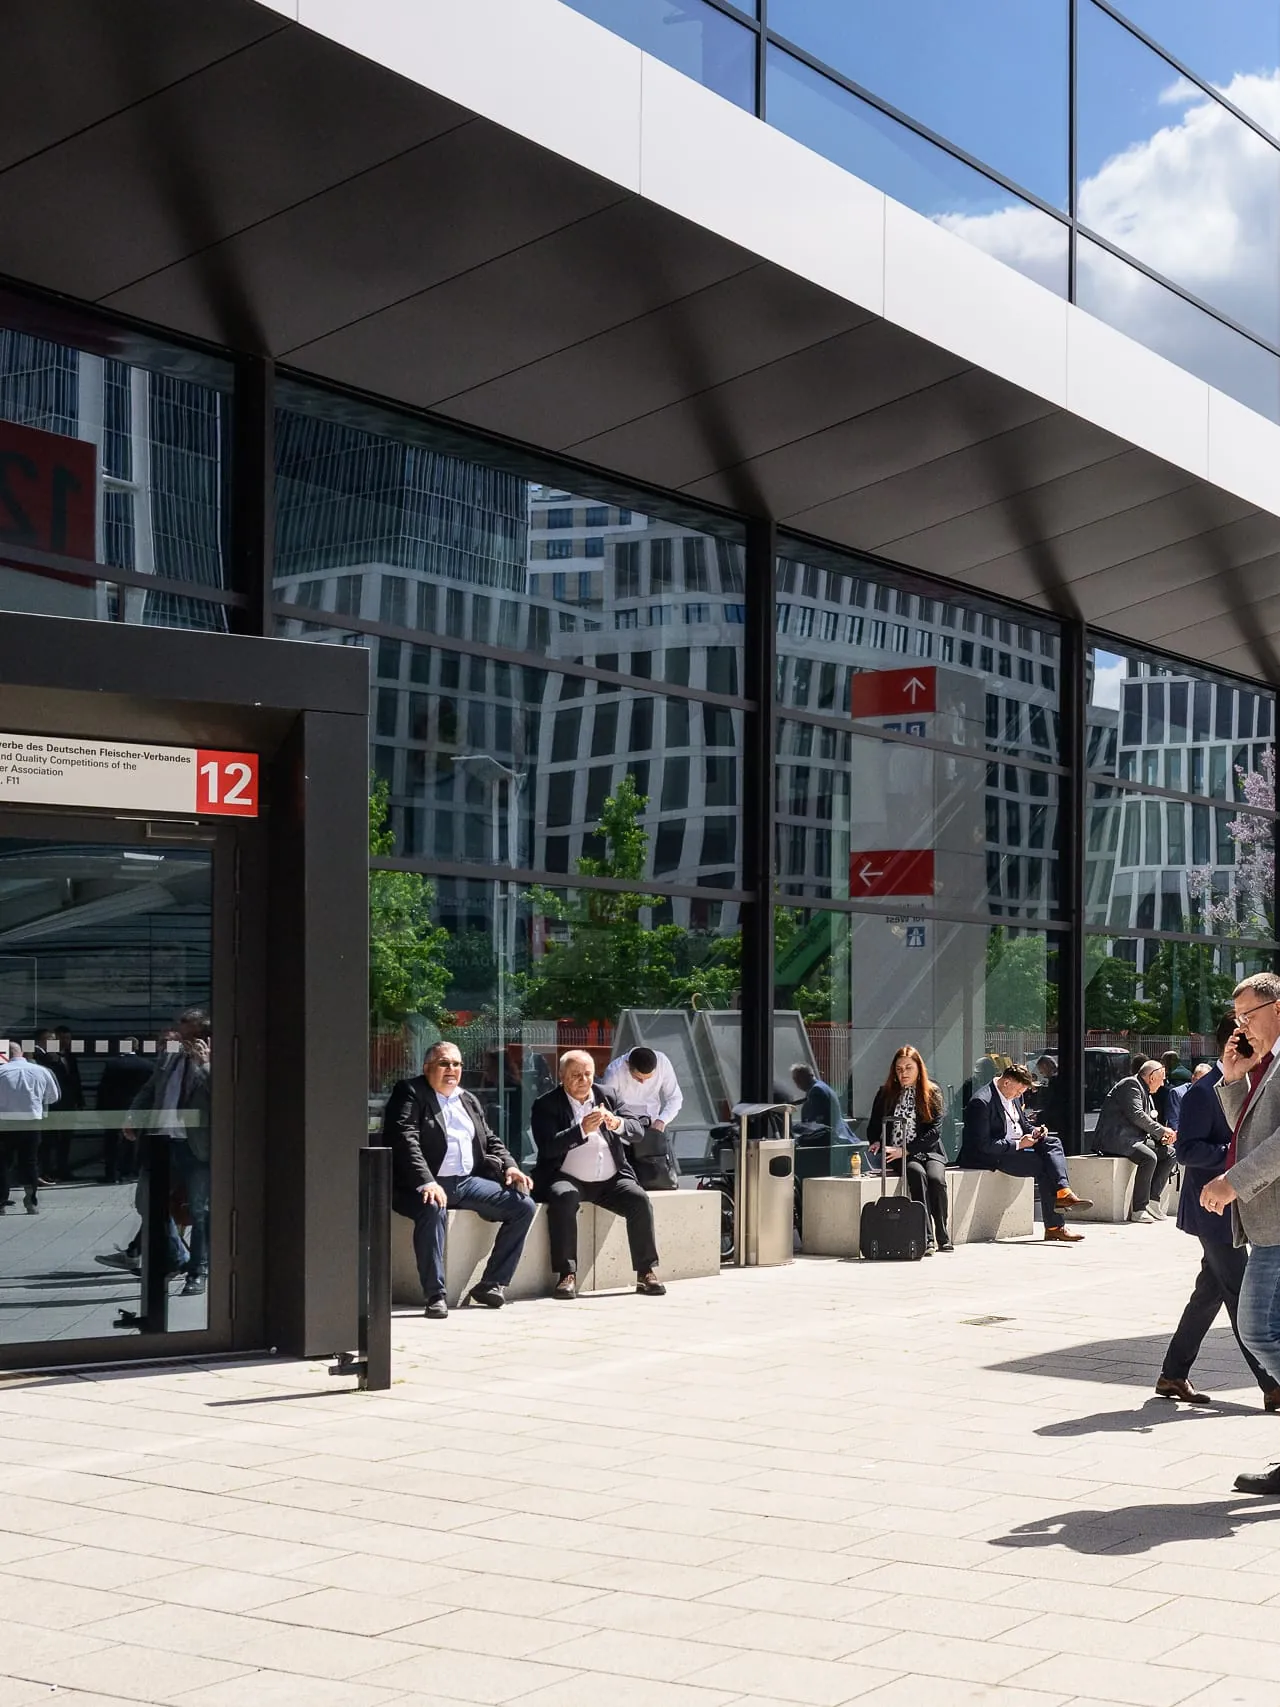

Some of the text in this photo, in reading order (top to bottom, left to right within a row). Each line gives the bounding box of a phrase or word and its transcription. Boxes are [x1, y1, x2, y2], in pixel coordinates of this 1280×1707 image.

[0, 741, 191, 764] erbe des Deutschen Fleischer-Verbandes
[11, 764, 64, 776] Association
[15, 753, 48, 765] Quality
[50, 756, 109, 769] Competitions
[111, 761, 121, 769] of
[123, 762, 137, 771] the
[6, 775, 20, 785] F11
[200, 761, 253, 806] 12
